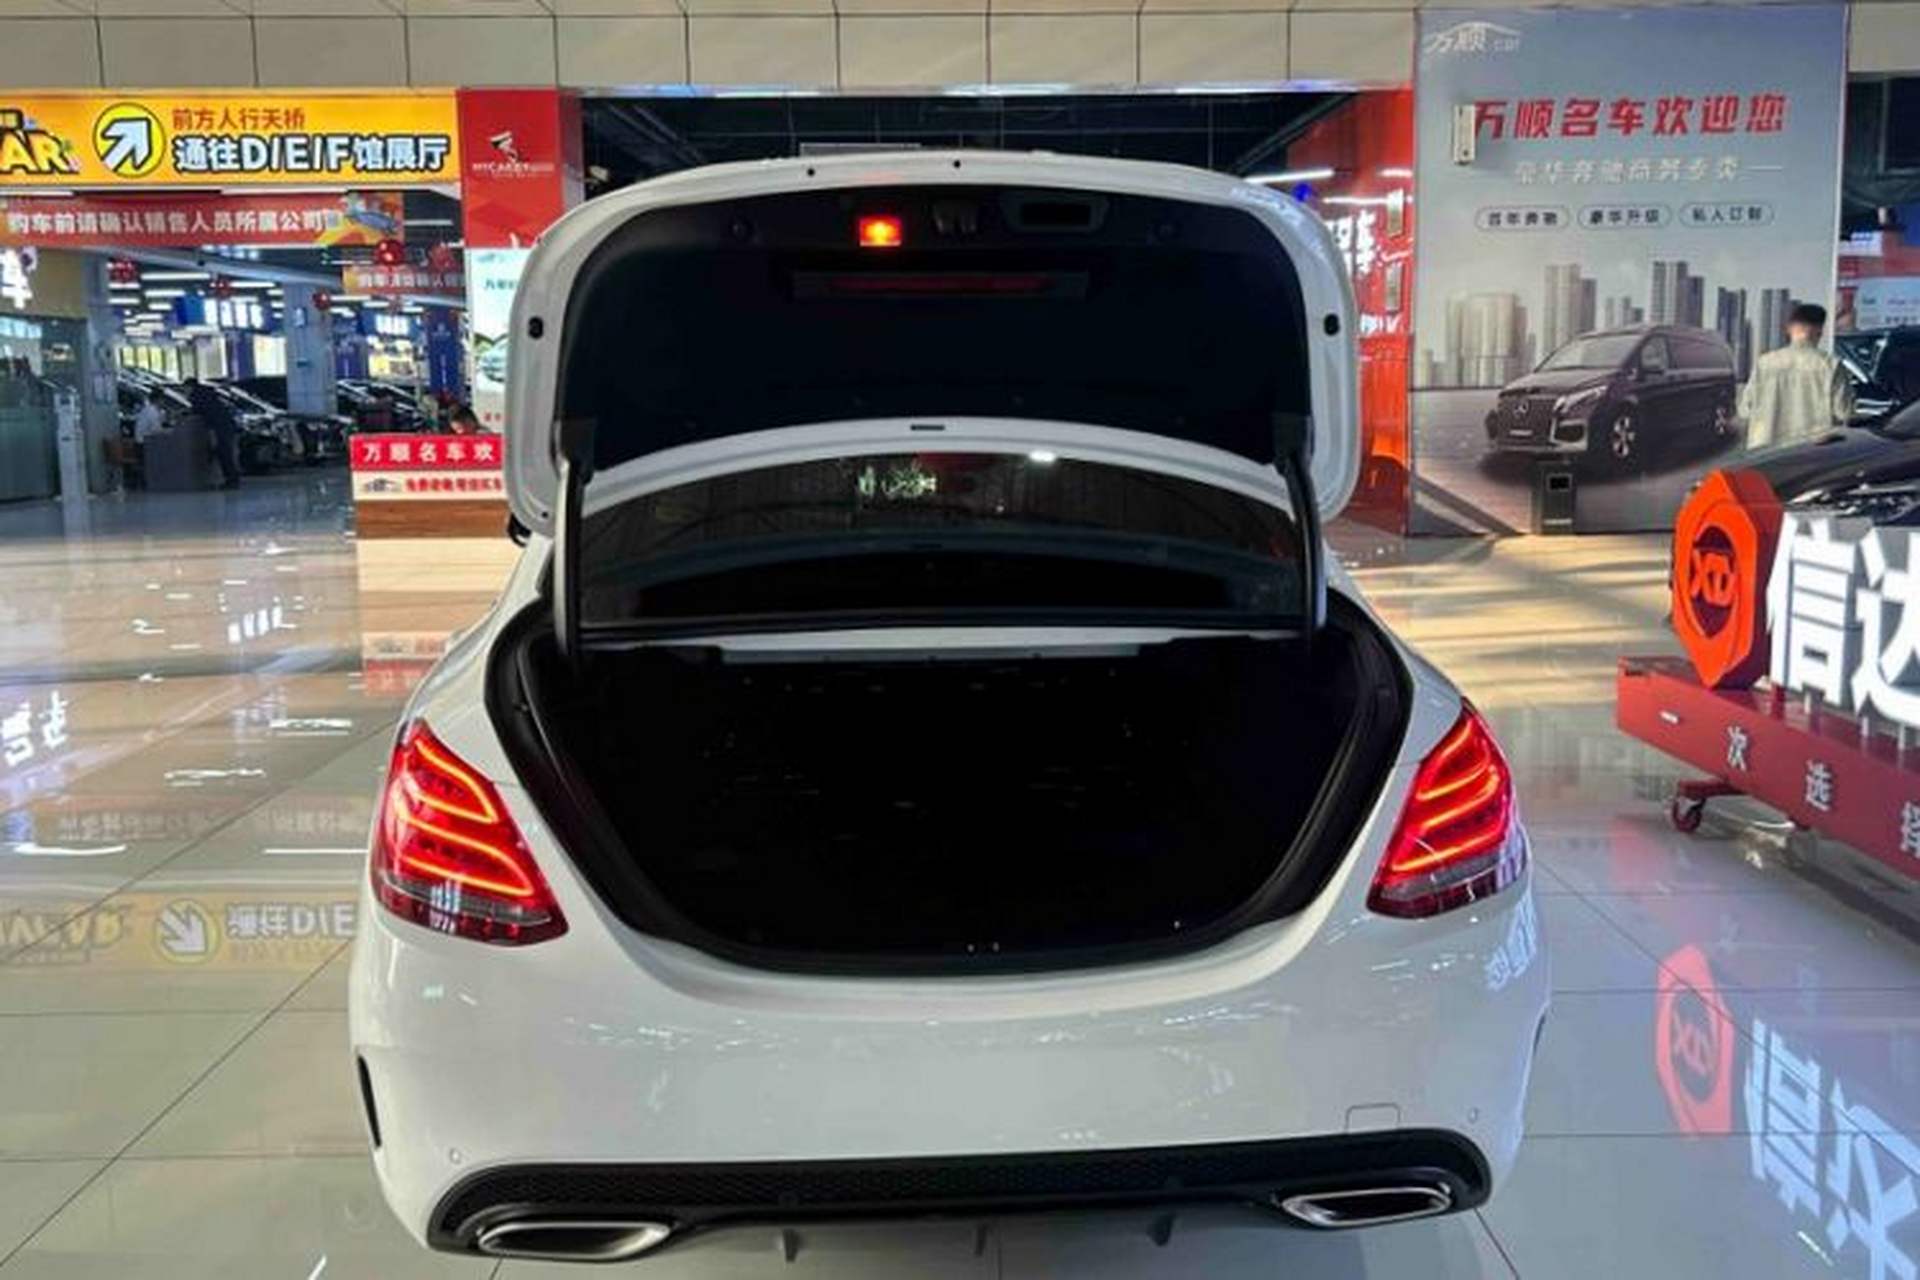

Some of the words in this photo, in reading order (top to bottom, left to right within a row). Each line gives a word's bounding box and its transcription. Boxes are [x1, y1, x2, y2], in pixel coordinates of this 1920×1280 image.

[173, 108, 307, 129] 前方人行天桥
[1474, 94, 1788, 140] 万顺名车欢迎您
[173, 135, 449, 172] 通往D/E/F馆展厅
